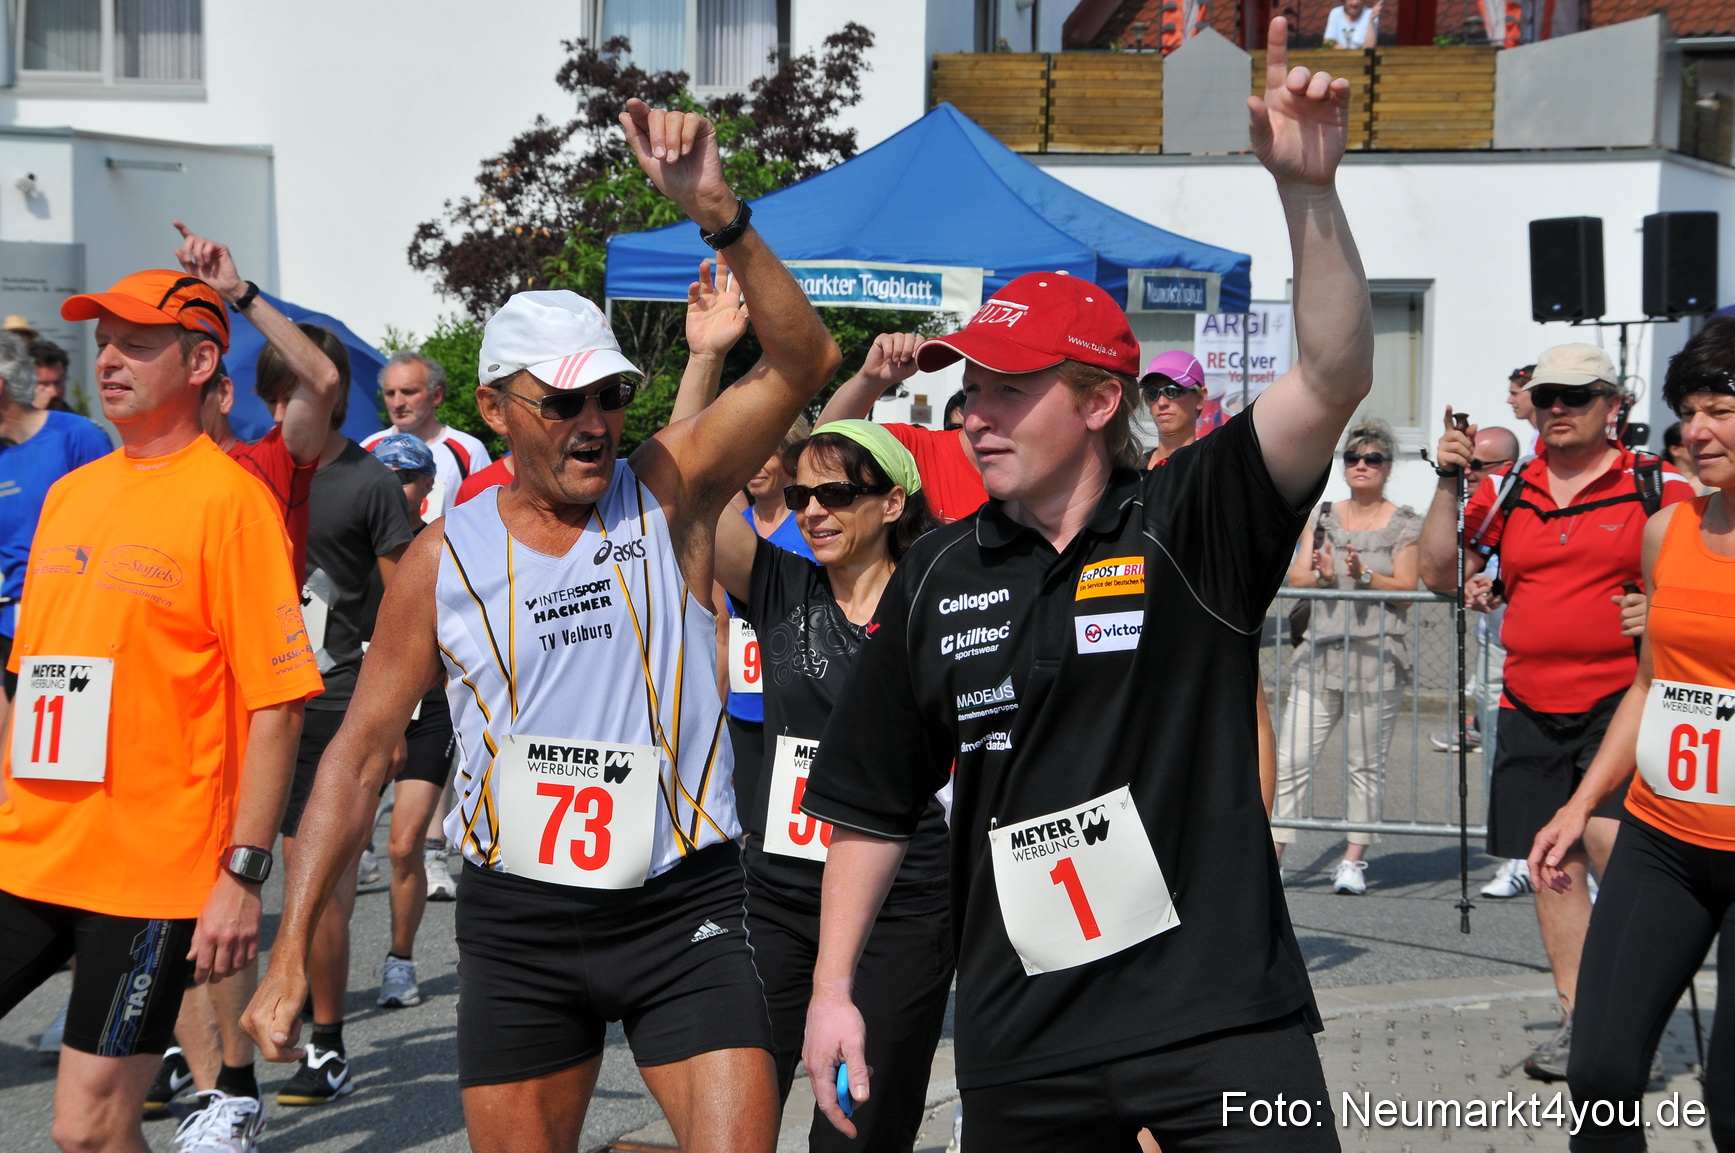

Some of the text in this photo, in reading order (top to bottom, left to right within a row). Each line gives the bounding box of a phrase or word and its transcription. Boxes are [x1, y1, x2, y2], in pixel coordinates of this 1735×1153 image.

[858, 274, 933, 300] Tagblatt
[1068, 335, 1117, 357] www.tuja.de
[1229, 370, 1276, 383] Yorself
[613, 538, 647, 562] asics
[539, 579, 611, 607] INTERSPORT
[1087, 581, 1104, 590] Service
[1105, 579, 1113, 588] der
[1114, 577, 1140, 587] Deutschen
[534, 595, 613, 624] HACKNER
[938, 588, 1010, 615] Cellagon
[539, 623, 613, 651] TV Velburg
[956, 626, 1010, 650] killtec
[954, 643, 1000, 661] sportswear
[31, 664, 66, 678] MEYER
[30, 678, 66, 690] WERBUNG
[1663, 686, 1713, 706] MEYER
[956, 685, 1015, 709] MADEUS
[1662, 700, 1713, 716] WERBUNG
[31, 694, 64, 764] 11
[527, 743, 600, 766] MEYER
[985, 741, 1005, 751] data
[527, 760, 599, 779] WERBUNG
[1667, 723, 1721, 795] 61
[536, 782, 614, 871] 73
[1010, 818, 1076, 850] MEYER
[1012, 835, 1080, 863] WERBUNG
[1049, 857, 1102, 941] 1
[124, 973, 152, 1021] TAO
